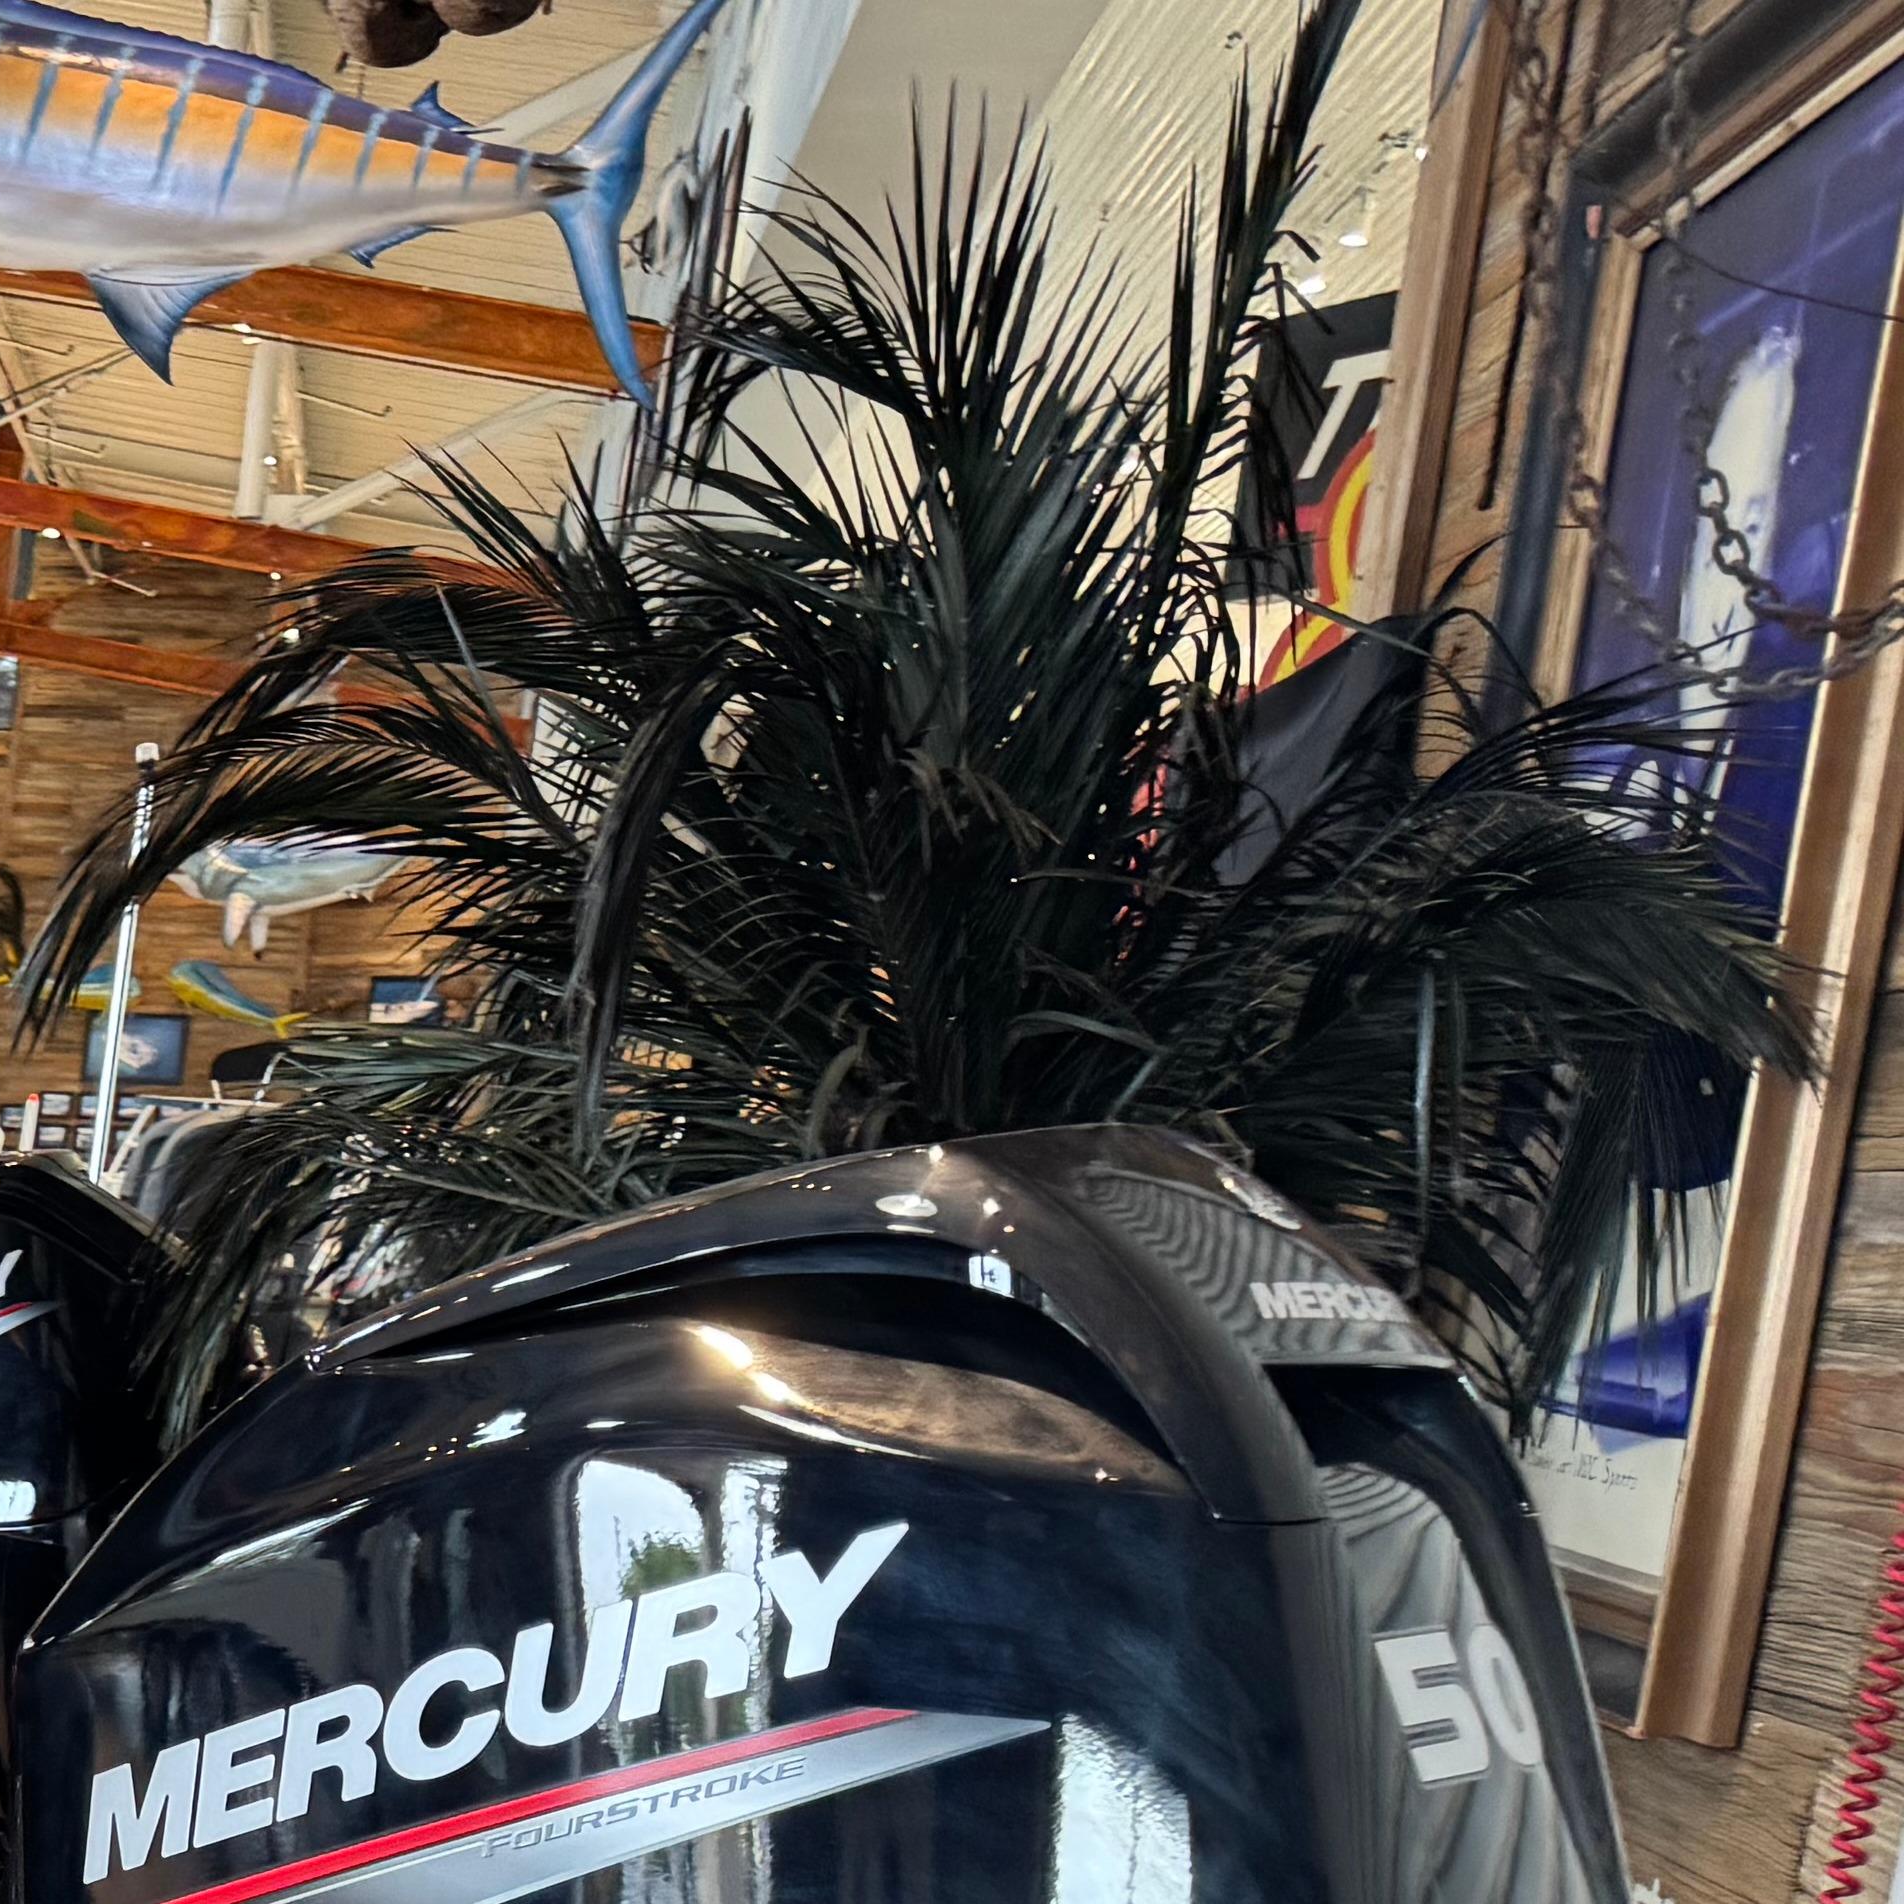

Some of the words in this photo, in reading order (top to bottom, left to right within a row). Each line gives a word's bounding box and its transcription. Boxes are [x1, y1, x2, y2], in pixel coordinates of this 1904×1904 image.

[1249, 1282, 1409, 1323] MERCUR
[82, 1520, 911, 1885] MERCURY
[1374, 1622, 1543, 1788] 50
